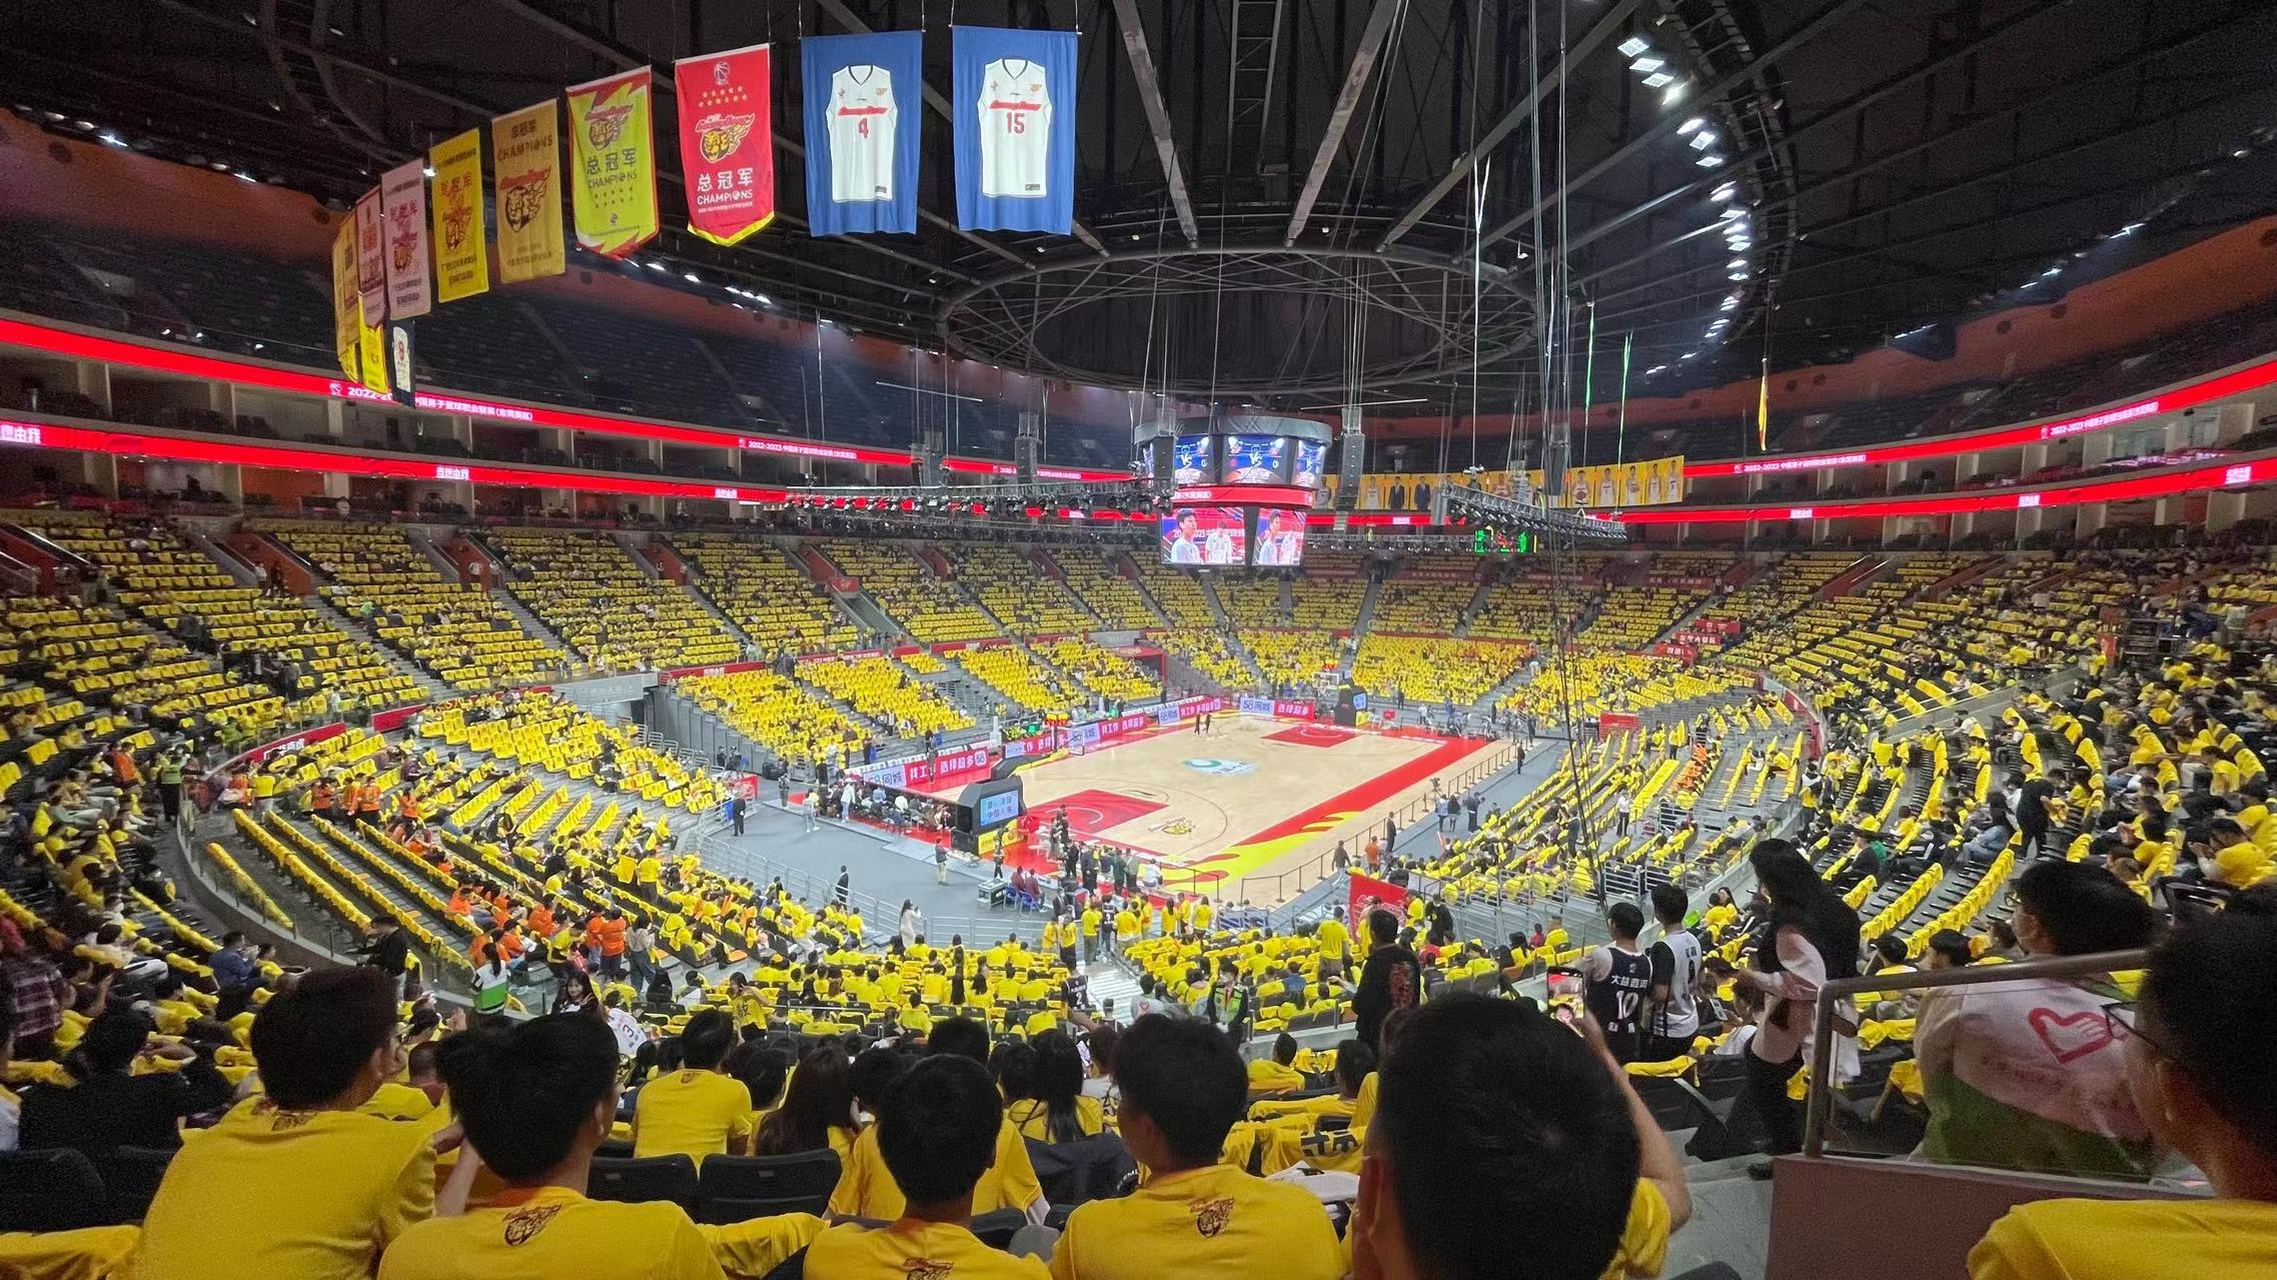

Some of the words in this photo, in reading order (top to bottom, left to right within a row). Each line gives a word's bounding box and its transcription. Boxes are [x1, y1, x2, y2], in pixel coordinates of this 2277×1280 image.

[858, 117, 869, 138] 4
[1006, 111, 1025, 134] 15
[587, 148, 637, 174] 总冠军
[588, 170, 638, 189] CHAMPIONS
[697, 167, 754, 192] 总冠军
[697, 189, 753, 206] CHAMPIONS
[748, 440, 782, 452] 2022-2023
[1242, 699, 1271, 713] 58同城
[940, 755, 974, 775] 选择超多
[1616, 990, 1639, 1020] 10
[622, 1024, 635, 1038] 3
